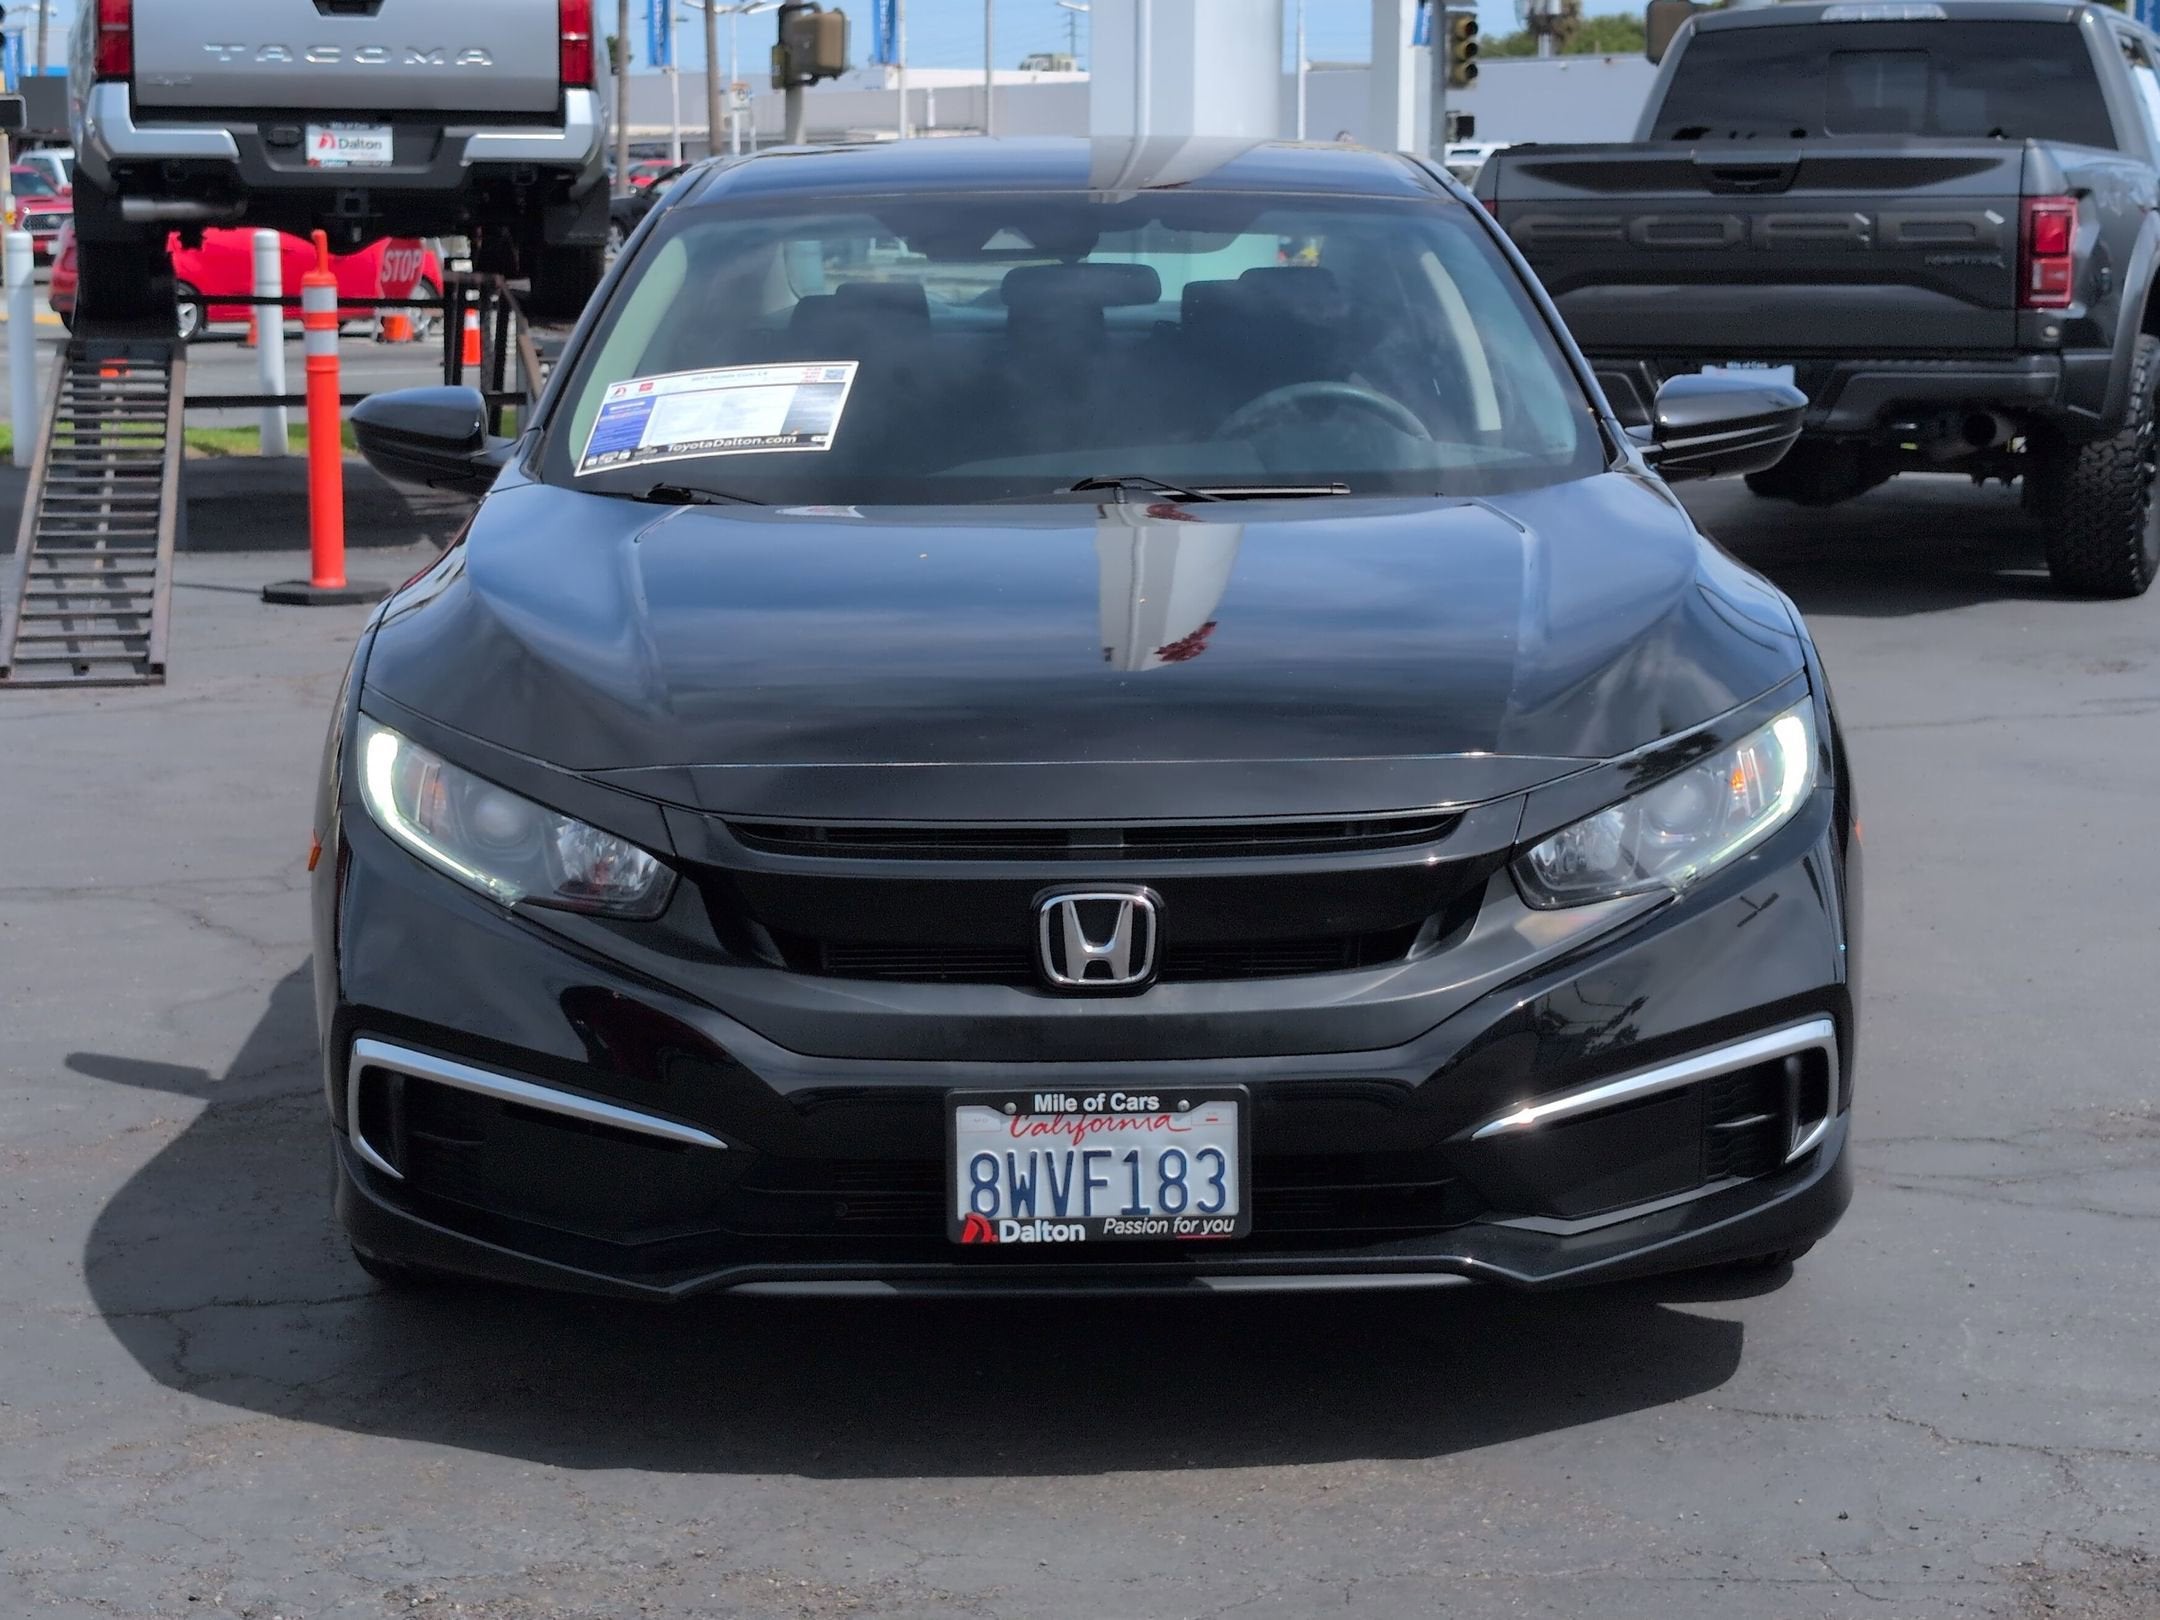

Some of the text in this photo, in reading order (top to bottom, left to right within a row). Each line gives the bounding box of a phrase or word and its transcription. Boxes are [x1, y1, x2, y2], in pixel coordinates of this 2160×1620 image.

[203, 44, 493, 66] TACOMA
[338, 137, 383, 150] Dalton
[382, 249, 422, 282] STOP
[668, 434, 797, 453] ToyotaDalton.com
[1034, 1092, 1160, 1112] Mile of Cars
[1009, 1113, 1192, 1146] California
[969, 1147, 1227, 1217] 8WVF183
[1000, 1219, 1086, 1243] Dalton
[1103, 1216, 1235, 1235] Passion for you
